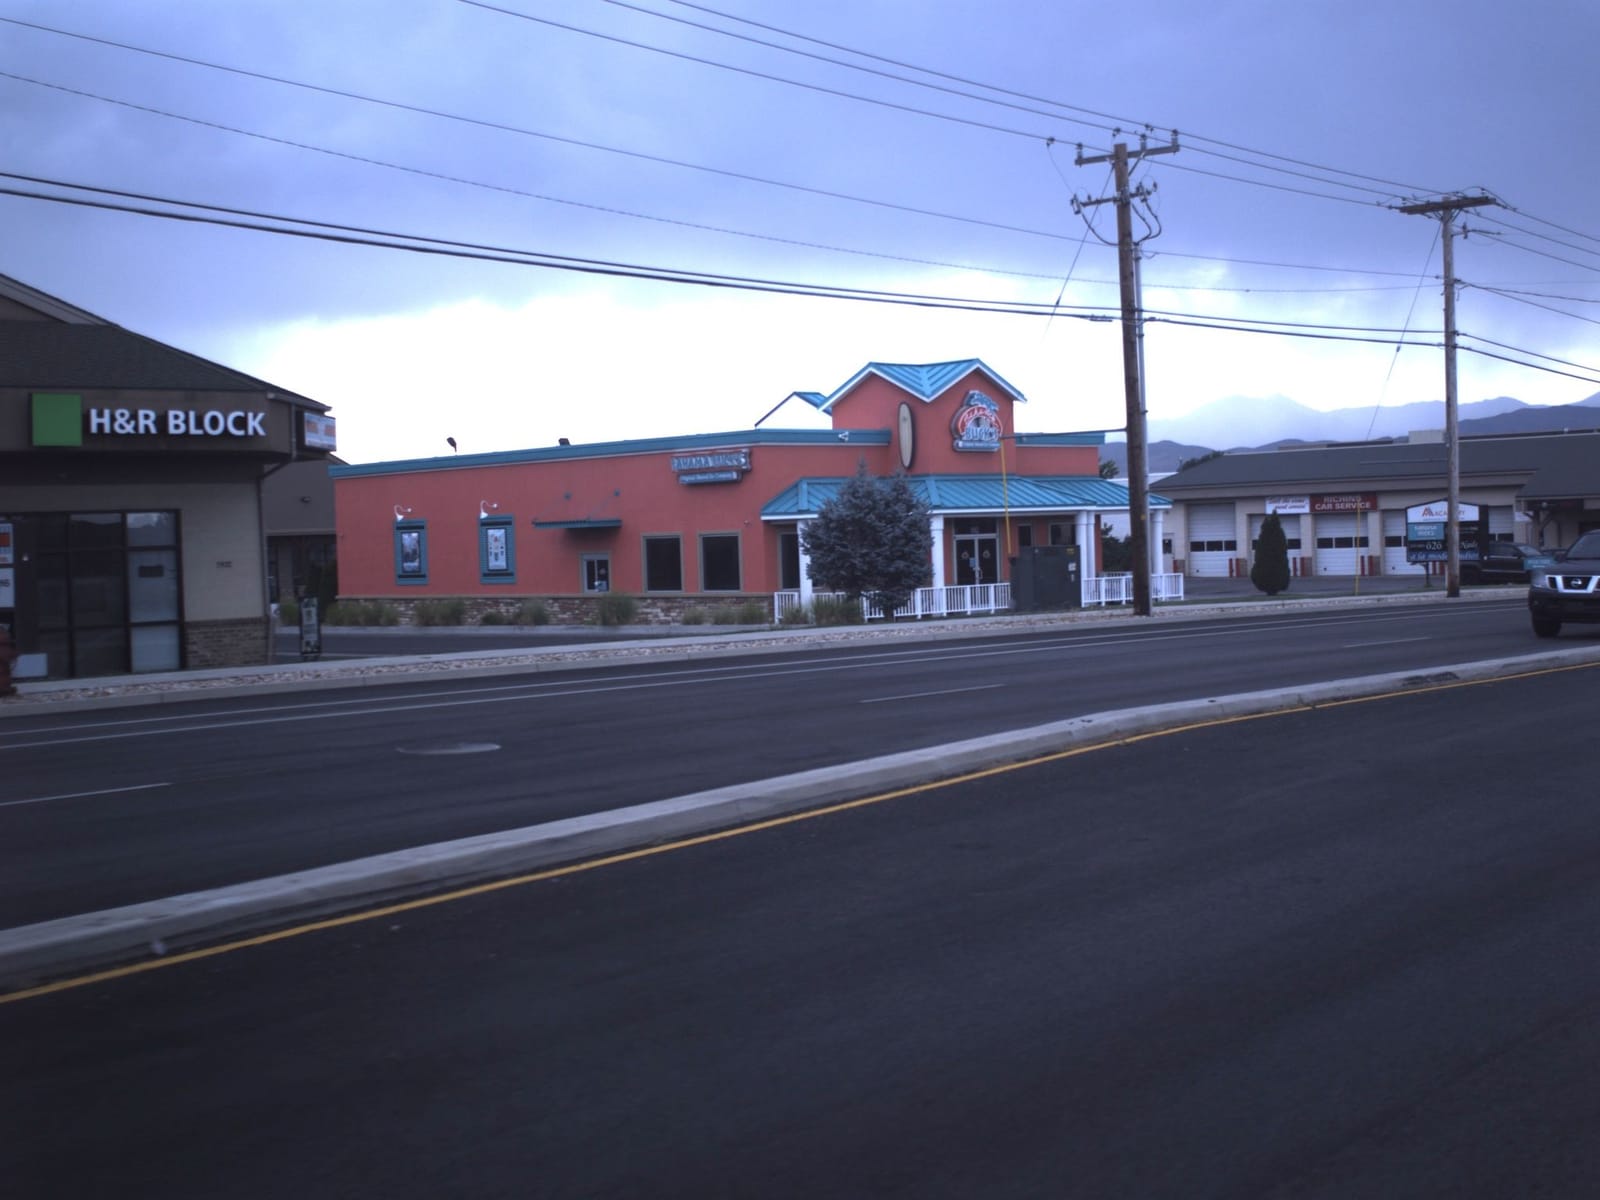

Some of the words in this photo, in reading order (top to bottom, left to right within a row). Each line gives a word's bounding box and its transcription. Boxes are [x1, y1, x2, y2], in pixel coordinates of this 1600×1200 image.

[89, 408, 157, 434] H&R
[167, 410, 266, 436] BLOCK
[1315, 503, 1333, 511] CAR
[1335, 501, 1371, 510] SERVCE
